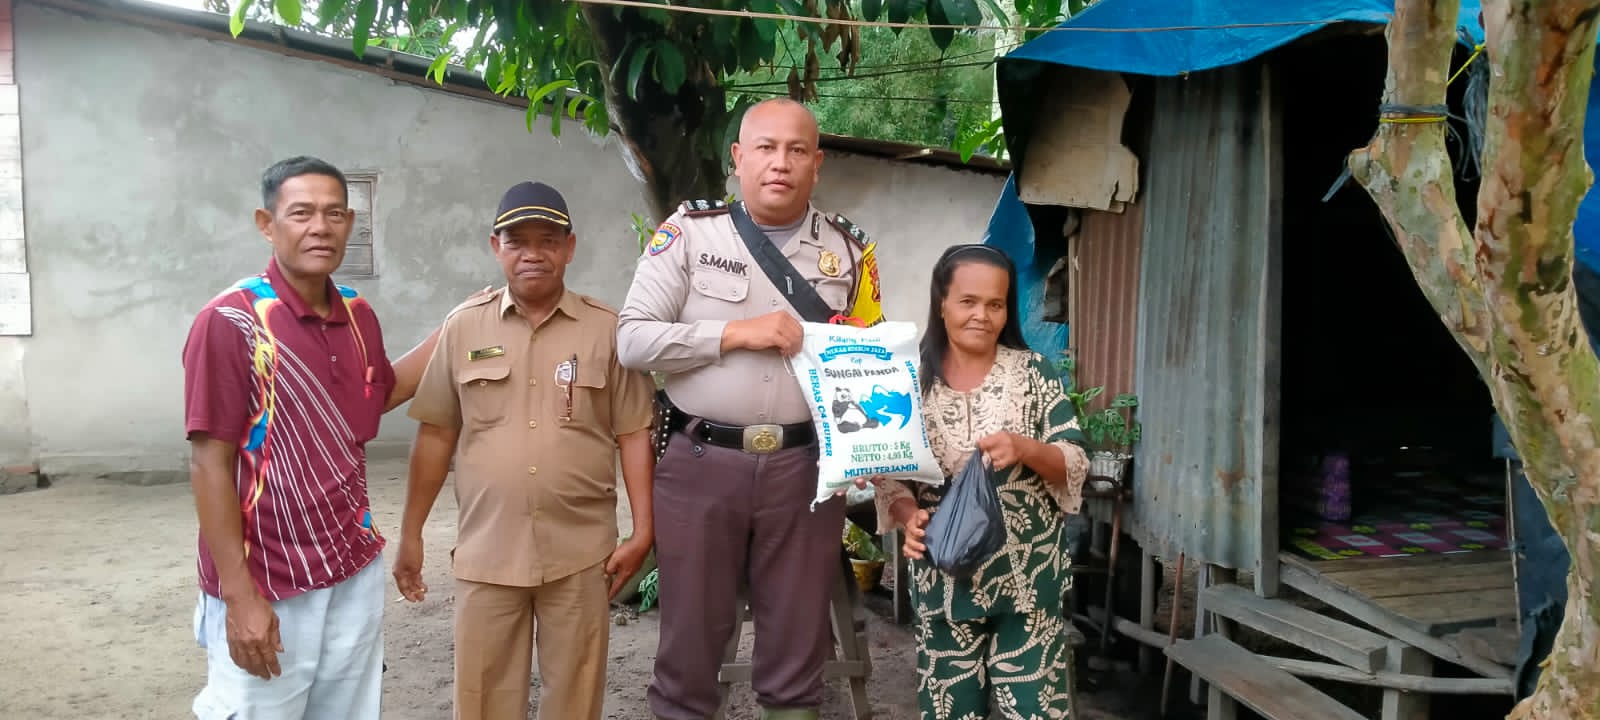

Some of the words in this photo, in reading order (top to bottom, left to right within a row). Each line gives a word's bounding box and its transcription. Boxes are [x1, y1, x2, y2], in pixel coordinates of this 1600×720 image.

[699, 253, 748, 276] S.MANIK
[824, 368, 862, 378] SUNGAI
[864, 367, 899, 376] PANDA
[808, 369, 823, 403] BERAS
[817, 405, 827, 419] C4
[822, 421, 832, 457] SUPER
[852, 443, 888, 452] BRUTTO
[851, 453, 881, 462] NETTO
[844, 467, 872, 478] MUTU
[874, 463, 919, 474] TERJAMIN
